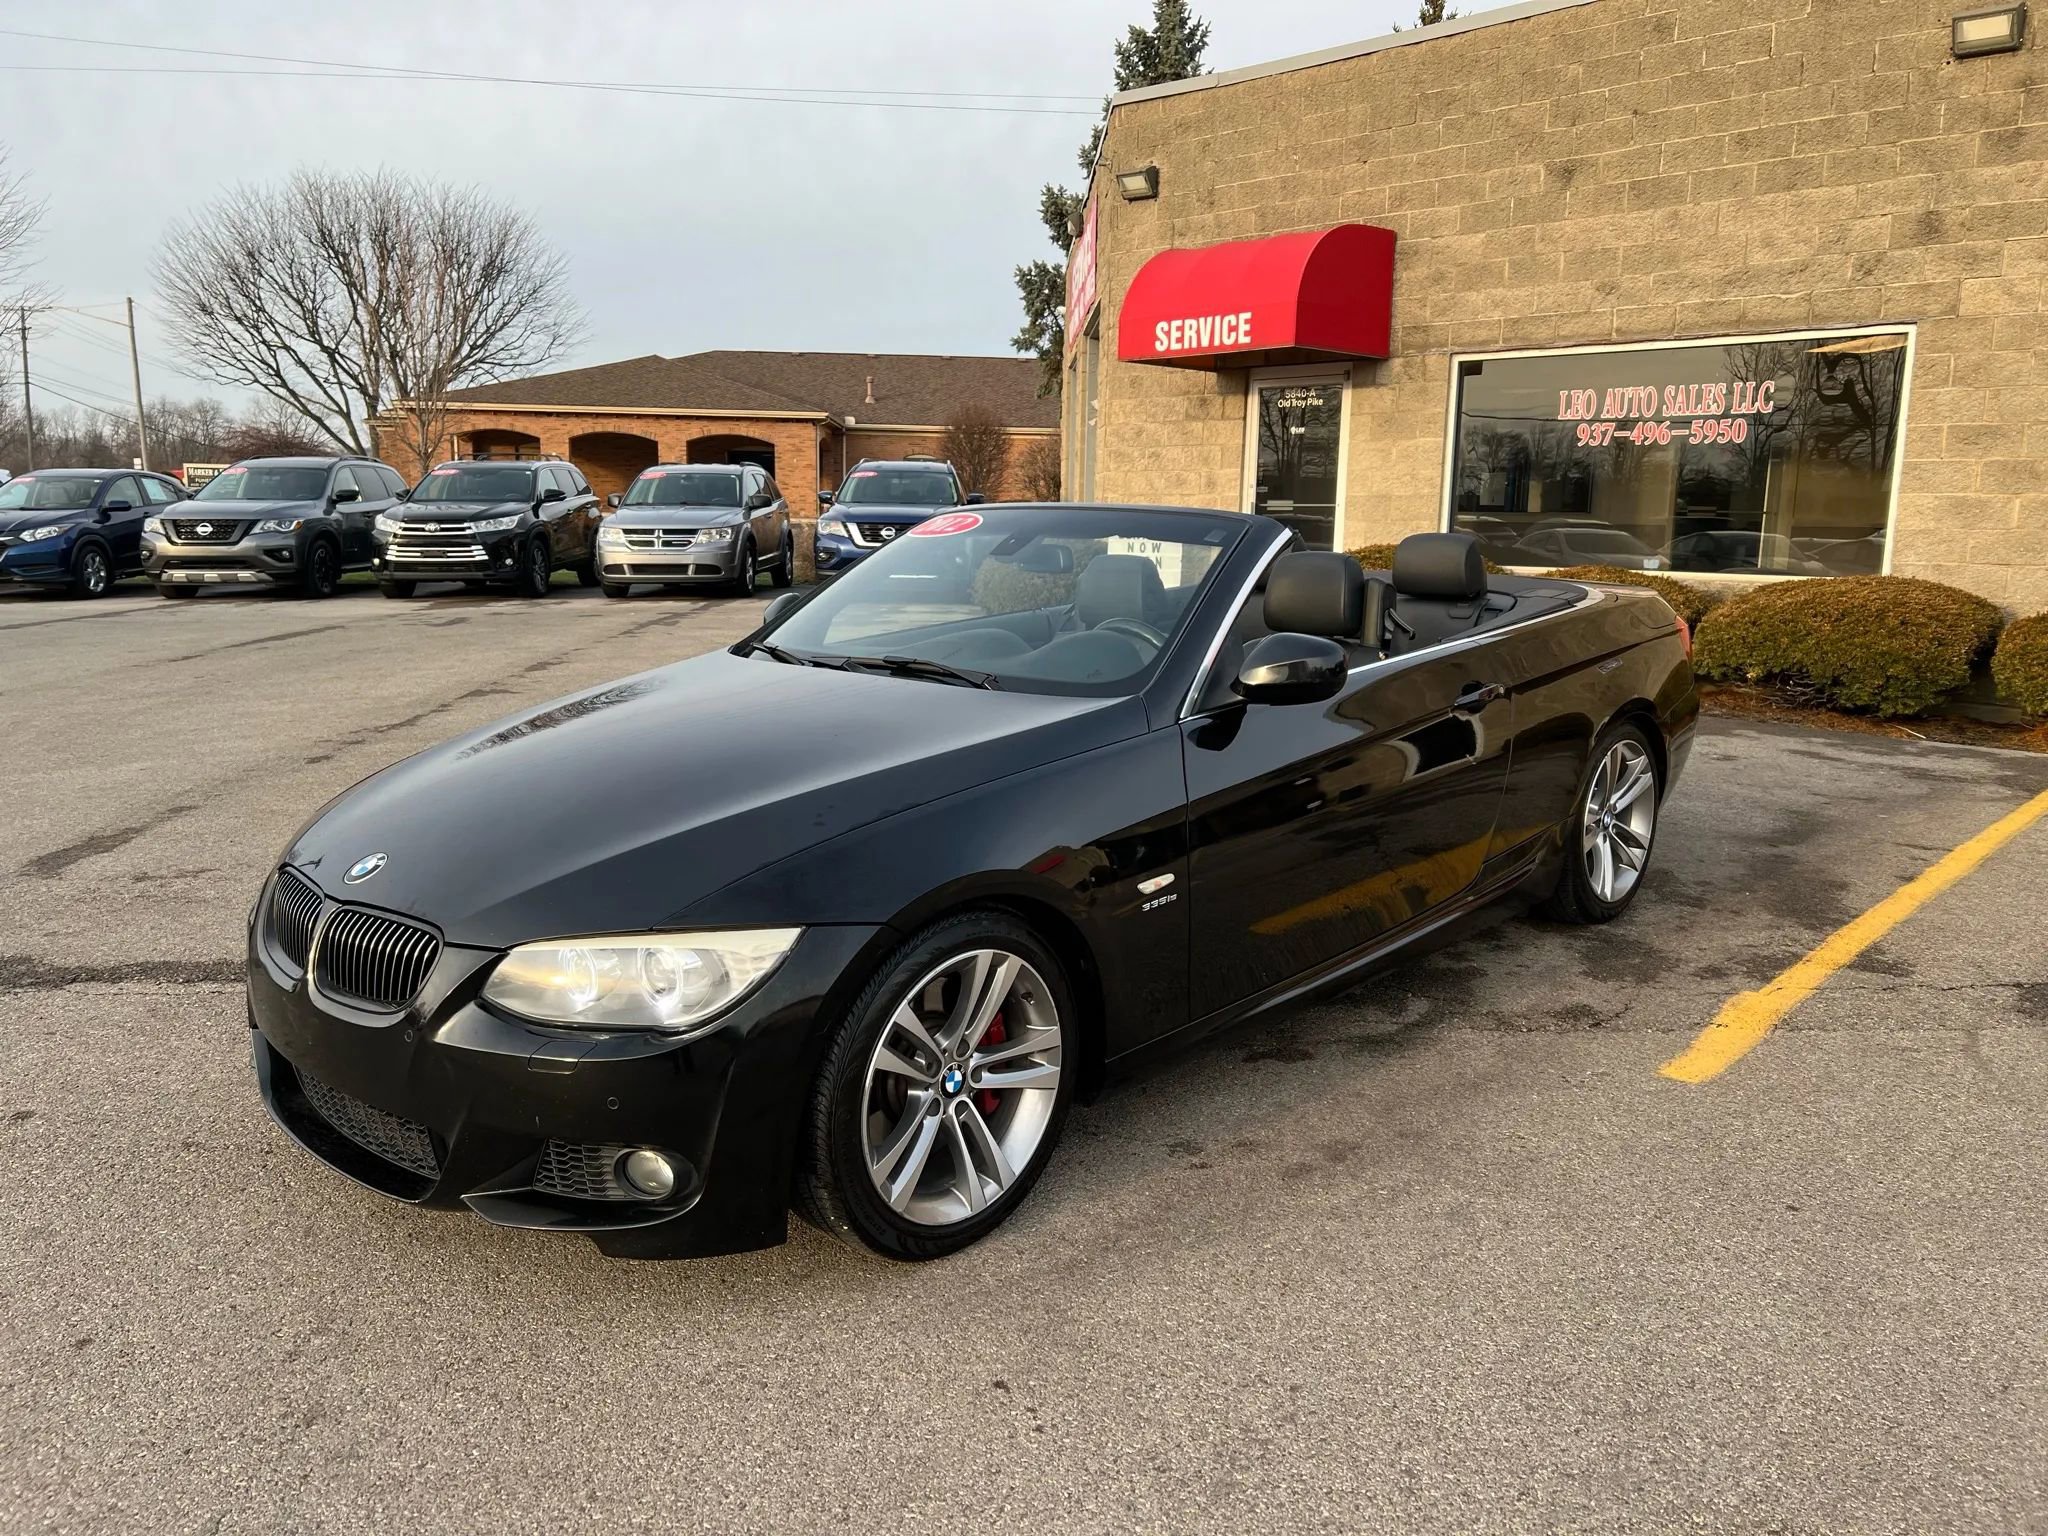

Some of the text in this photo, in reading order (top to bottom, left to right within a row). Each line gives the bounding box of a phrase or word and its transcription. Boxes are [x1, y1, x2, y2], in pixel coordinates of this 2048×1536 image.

[1155, 312, 1252, 351] SERVICE
[1285, 388, 1316, 399] 5840-A
[1277, 398, 1323, 409] Old Troy Pike
[1558, 380, 1775, 420] LEO AUTO SALES LLC
[1577, 418, 1747, 447] 937-496-5950
[188, 467, 213, 476] MARKER
[1127, 541, 1162, 553] NOW
